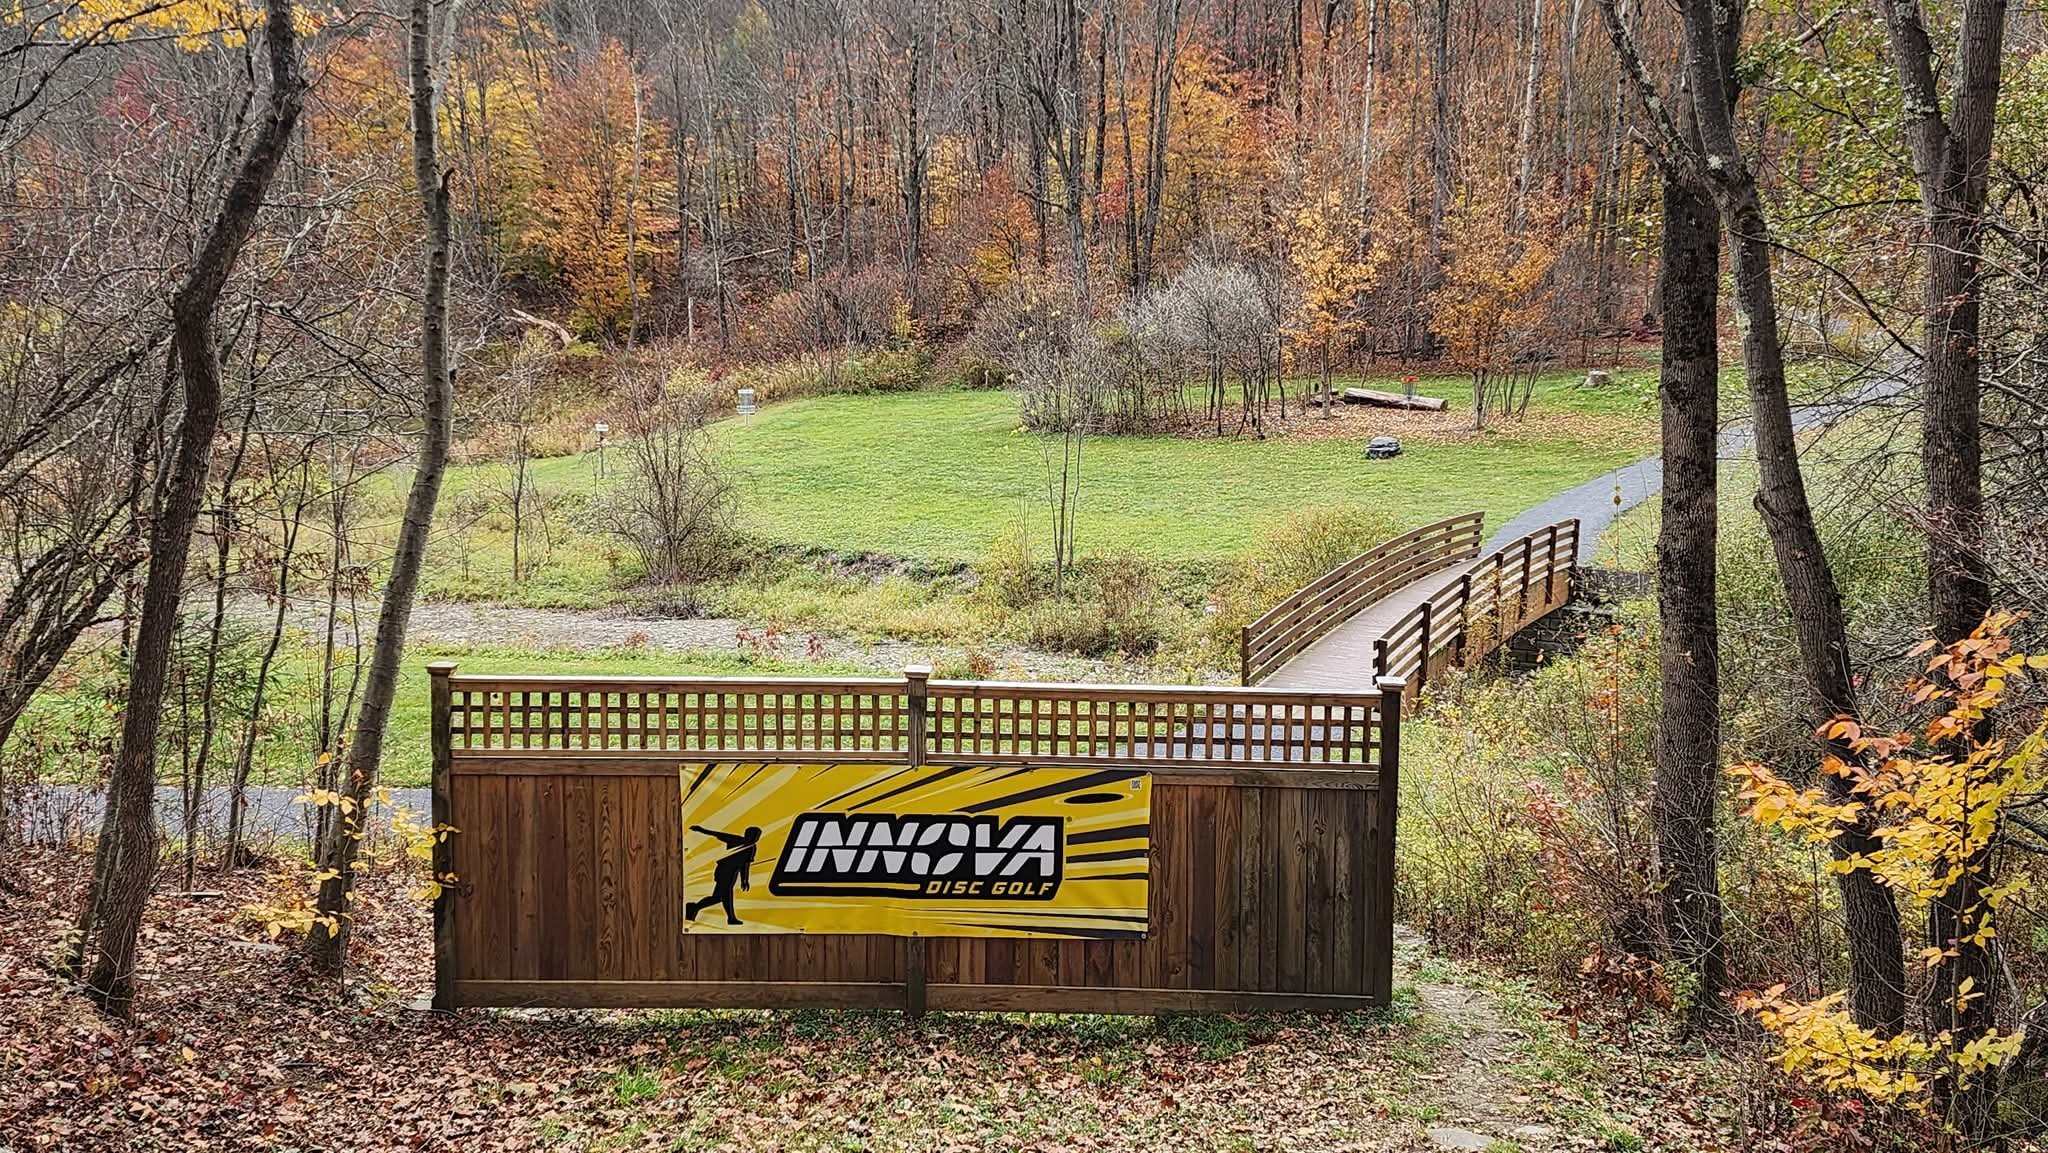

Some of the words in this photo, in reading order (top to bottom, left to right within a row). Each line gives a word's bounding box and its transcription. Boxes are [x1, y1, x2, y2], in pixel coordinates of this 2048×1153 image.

[784, 821, 1055, 876] INNOVA
[925, 881, 984, 895] DISC
[991, 882, 1054, 895] GOLF
